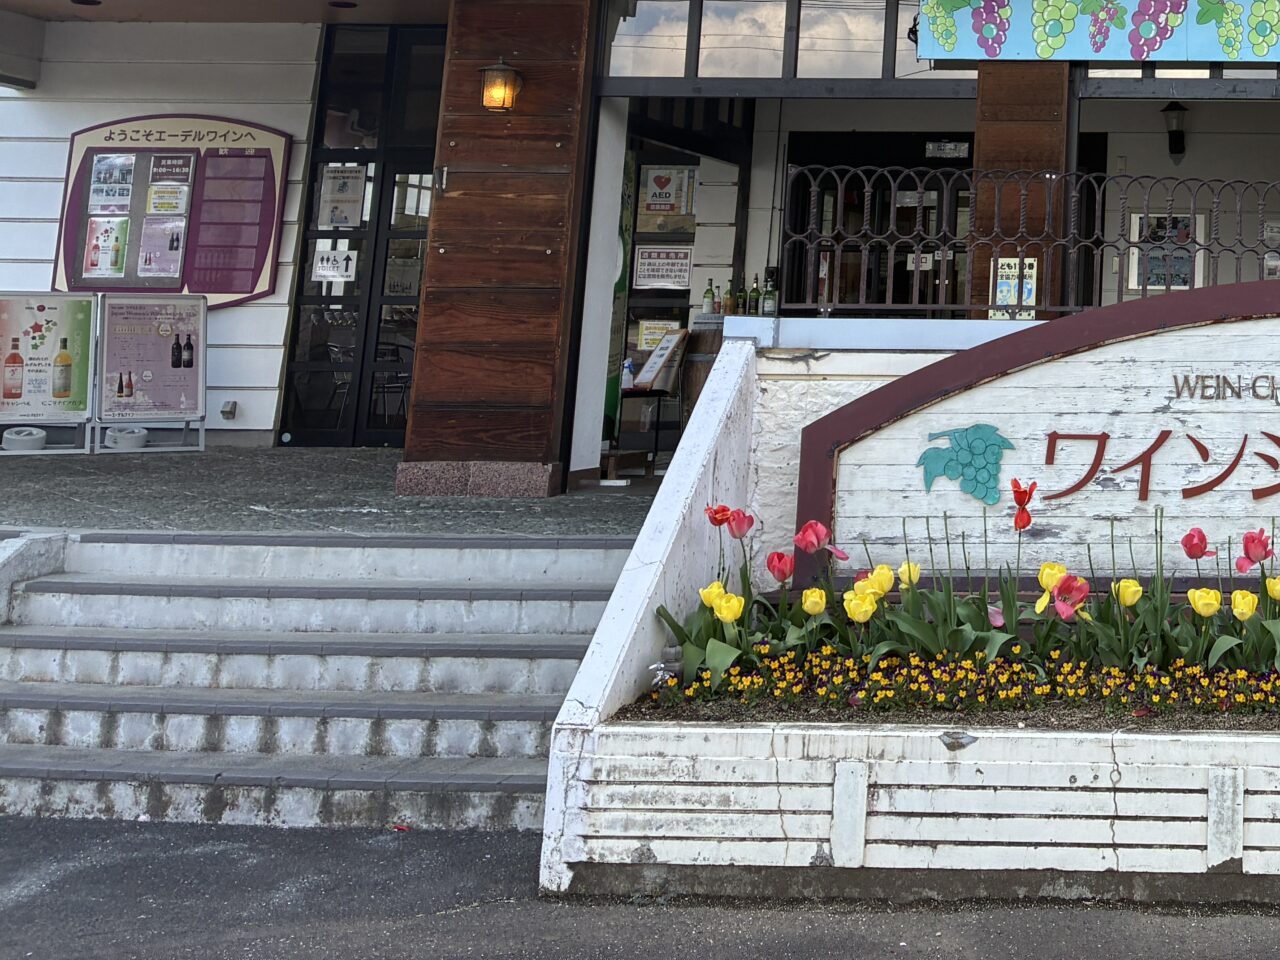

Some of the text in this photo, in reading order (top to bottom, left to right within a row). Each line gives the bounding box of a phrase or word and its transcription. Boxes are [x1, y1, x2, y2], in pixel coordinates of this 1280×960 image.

[104, 129, 257, 142] ようこそエーデルワインへ
[651, 191, 672, 199] AED
[1172, 374, 1243, 400] WEIN
